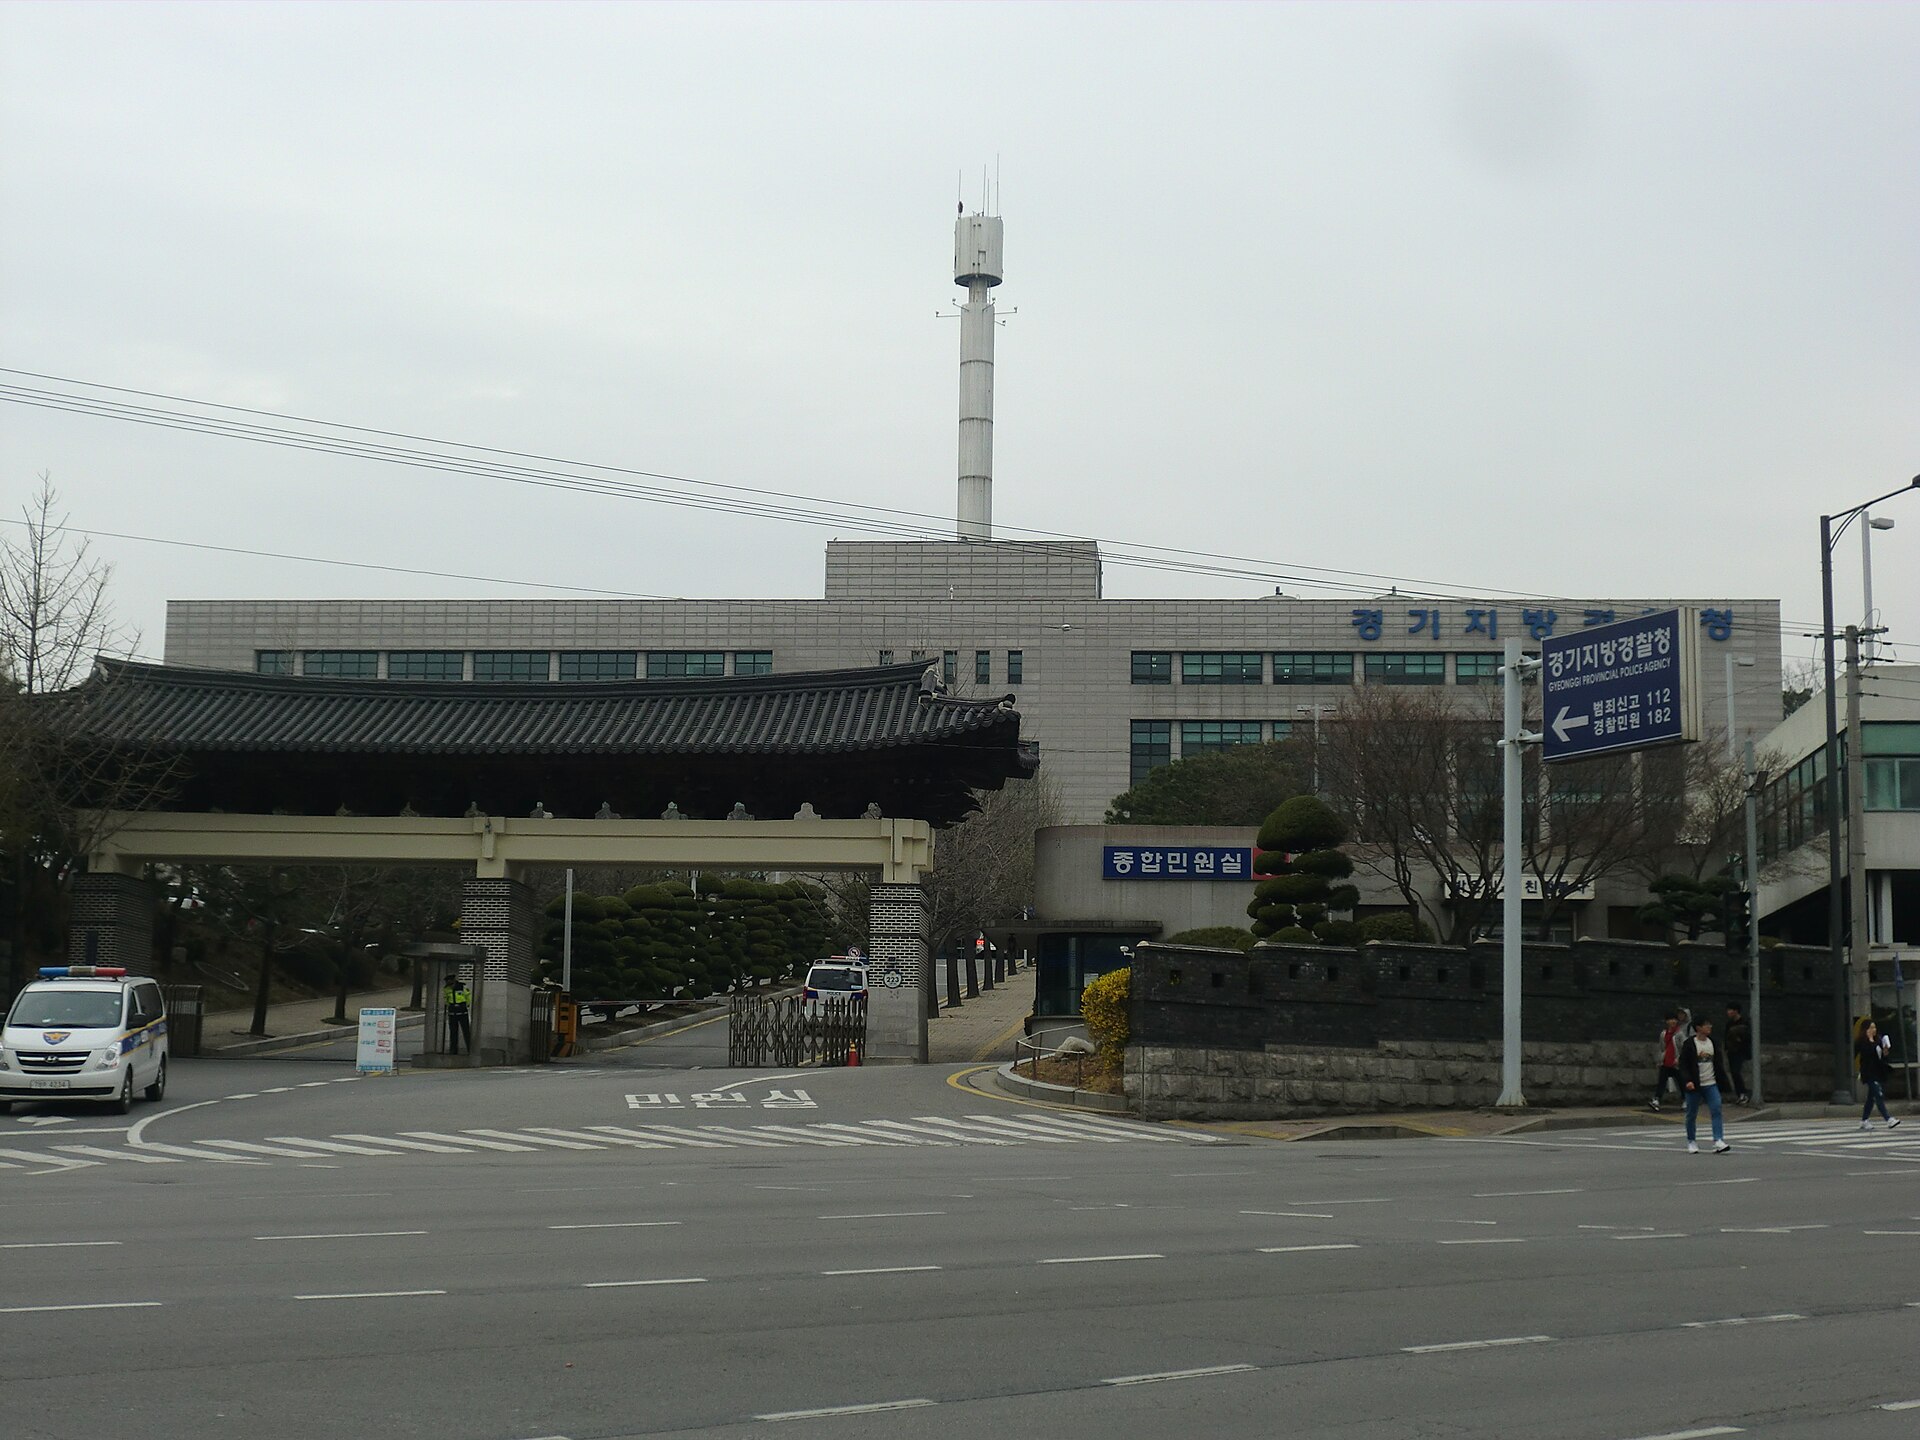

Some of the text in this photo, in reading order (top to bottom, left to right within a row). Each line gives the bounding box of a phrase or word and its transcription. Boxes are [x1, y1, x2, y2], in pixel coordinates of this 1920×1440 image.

[1548, 626, 1671, 677] 경기지방경찰청
[1548, 657, 1671, 692] GYEONGGI PROVINCIAL POLICE AGENCY
[1593, 687, 1671, 717] 범죄신고 112
[1594, 707, 1671, 736] 경찰민원 182
[1112, 851, 1242, 874] 종합민원실
[624, 1089, 819, 1109] 민원실
